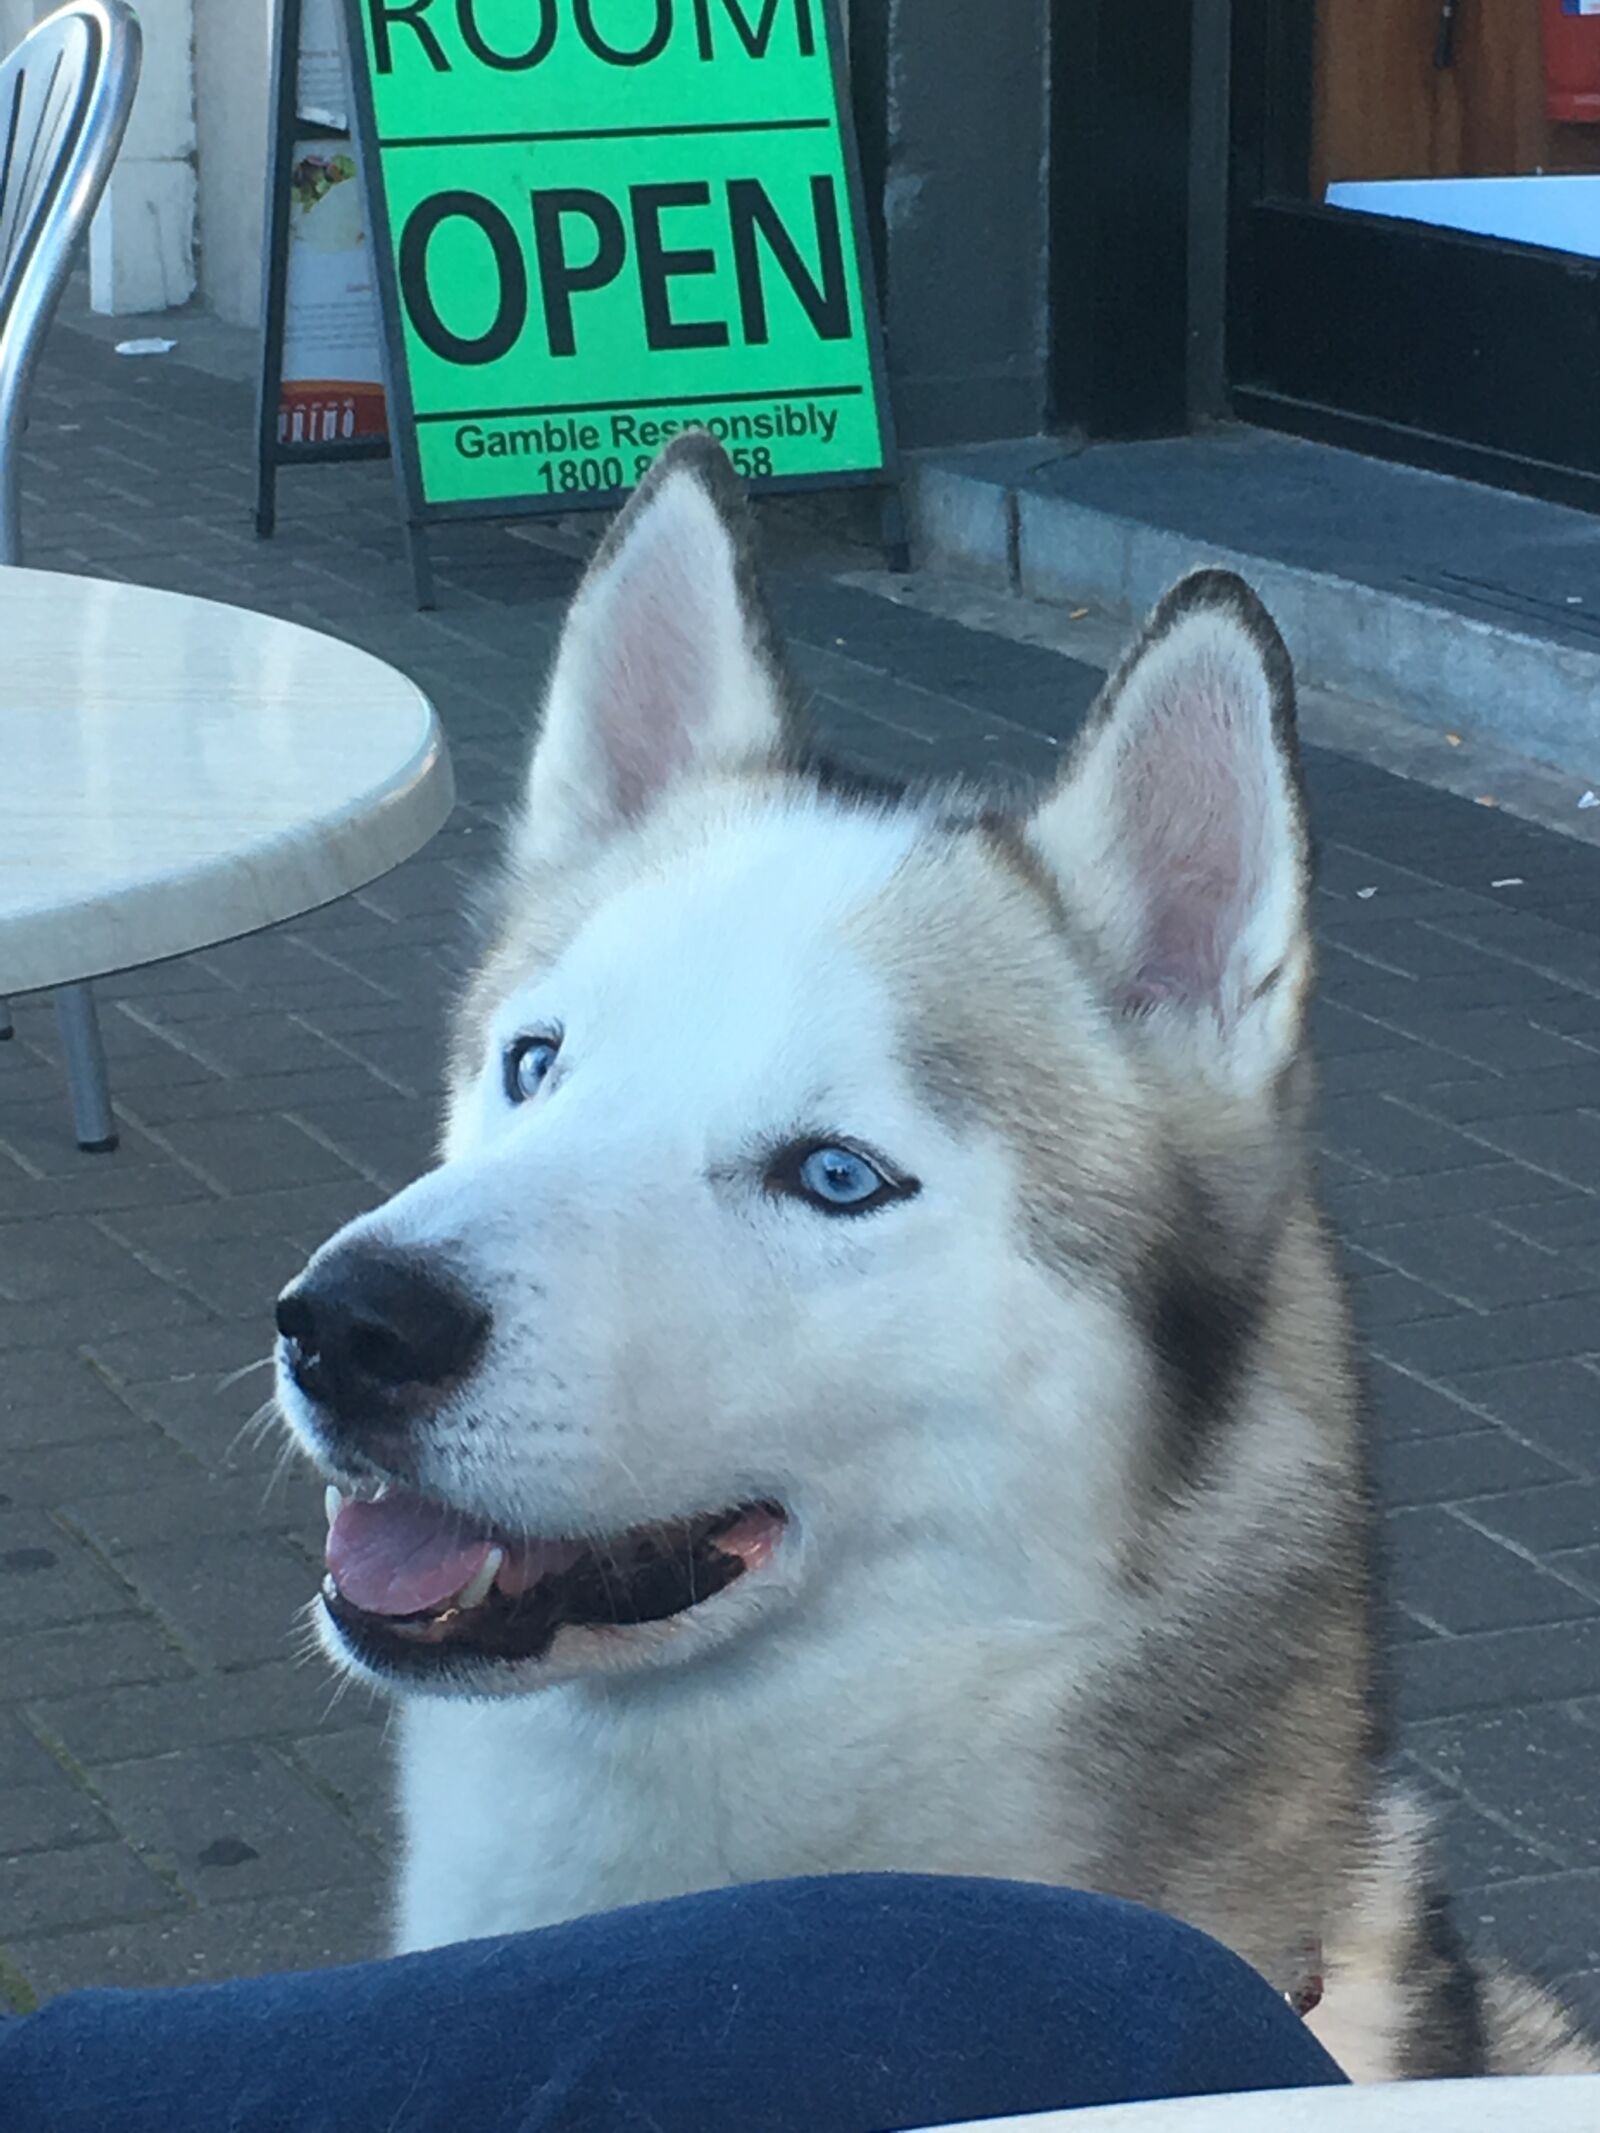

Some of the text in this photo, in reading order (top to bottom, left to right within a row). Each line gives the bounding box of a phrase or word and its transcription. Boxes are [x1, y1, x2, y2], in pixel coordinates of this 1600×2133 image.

[399, 175, 852, 365] OPEN
[455, 419, 599, 458] Gamble
[538, 456, 623, 494] 1800
